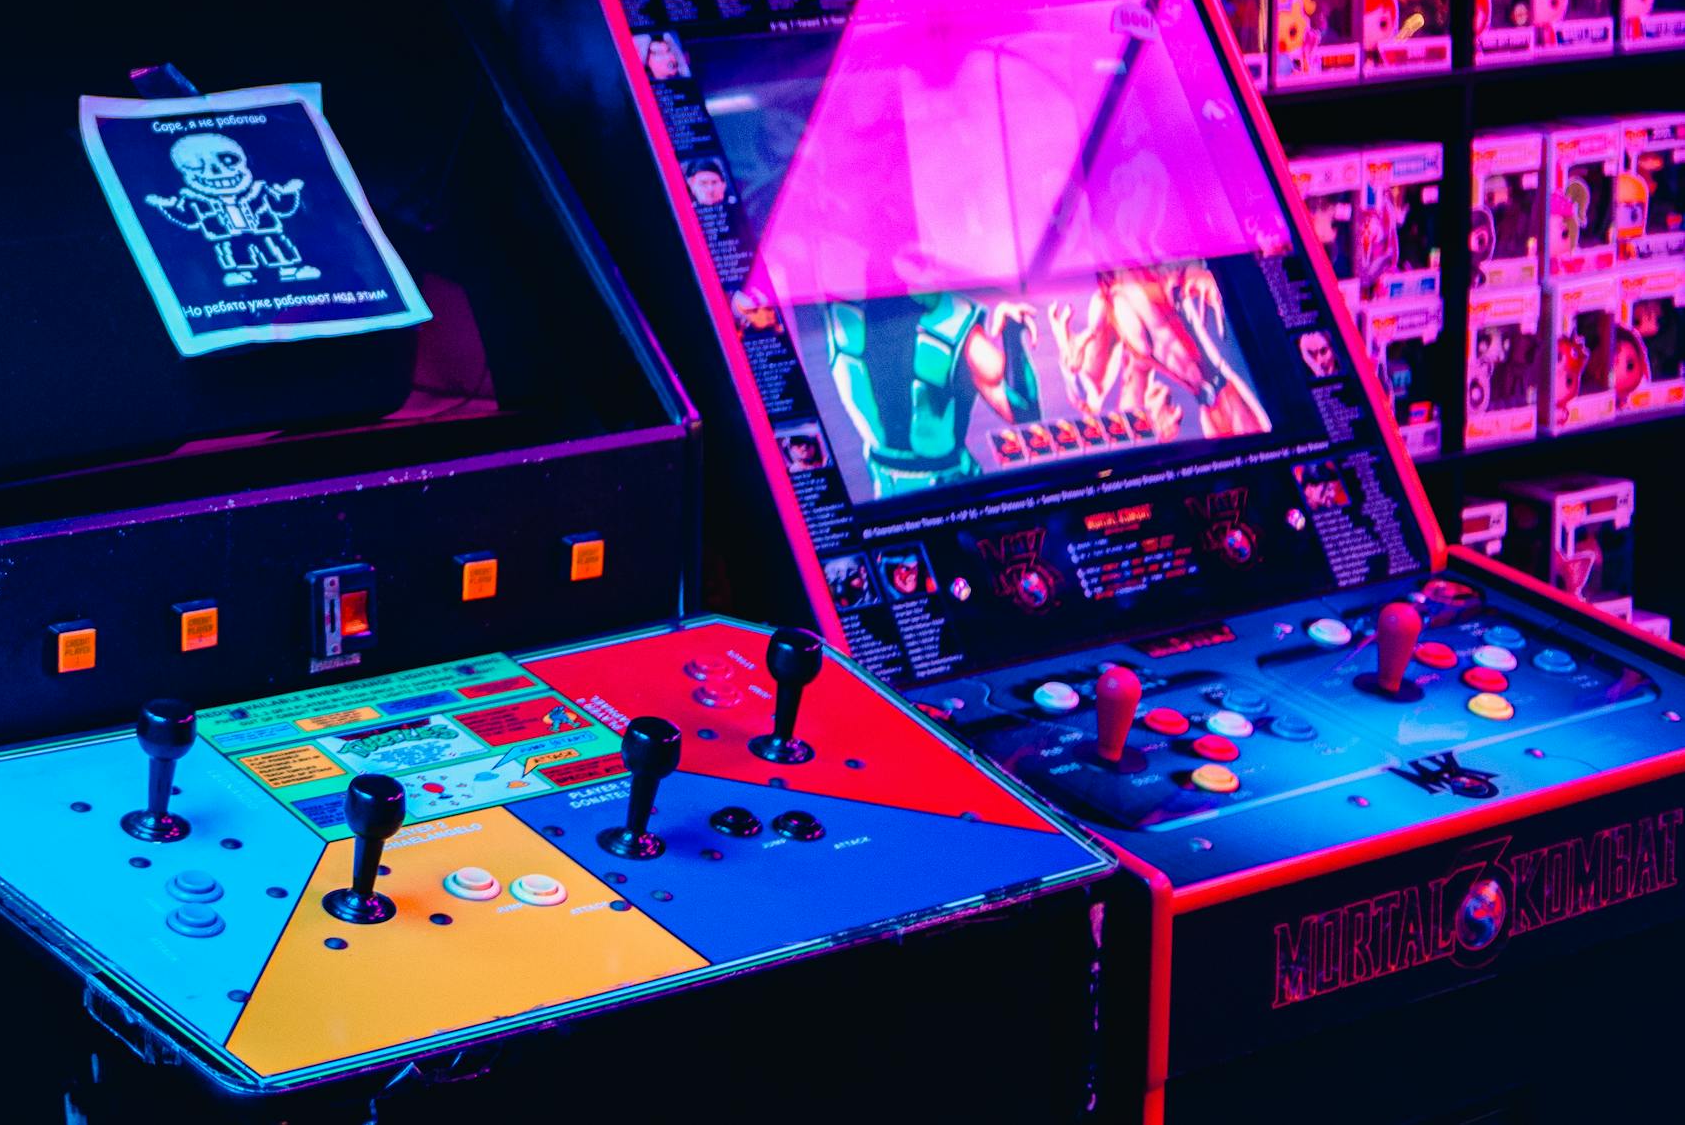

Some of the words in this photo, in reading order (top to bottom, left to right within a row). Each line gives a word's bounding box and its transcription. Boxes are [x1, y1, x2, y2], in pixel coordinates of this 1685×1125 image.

[189, 120, 197, 129] я
[199, 118, 214, 128] не
[216, 113, 267, 128] работаю
[184, 306, 202, 317] Но
[205, 299, 246, 318] ребята
[248, 298, 273, 312] уже
[274, 292, 330, 307] работают
[332, 290, 356, 304] над
[358, 288, 388, 302] этим
[569, 783, 616, 800] PLAYER
[1271, 880, 1455, 1009] MORTAL
[1508, 809, 1685, 937] KOMBAT
